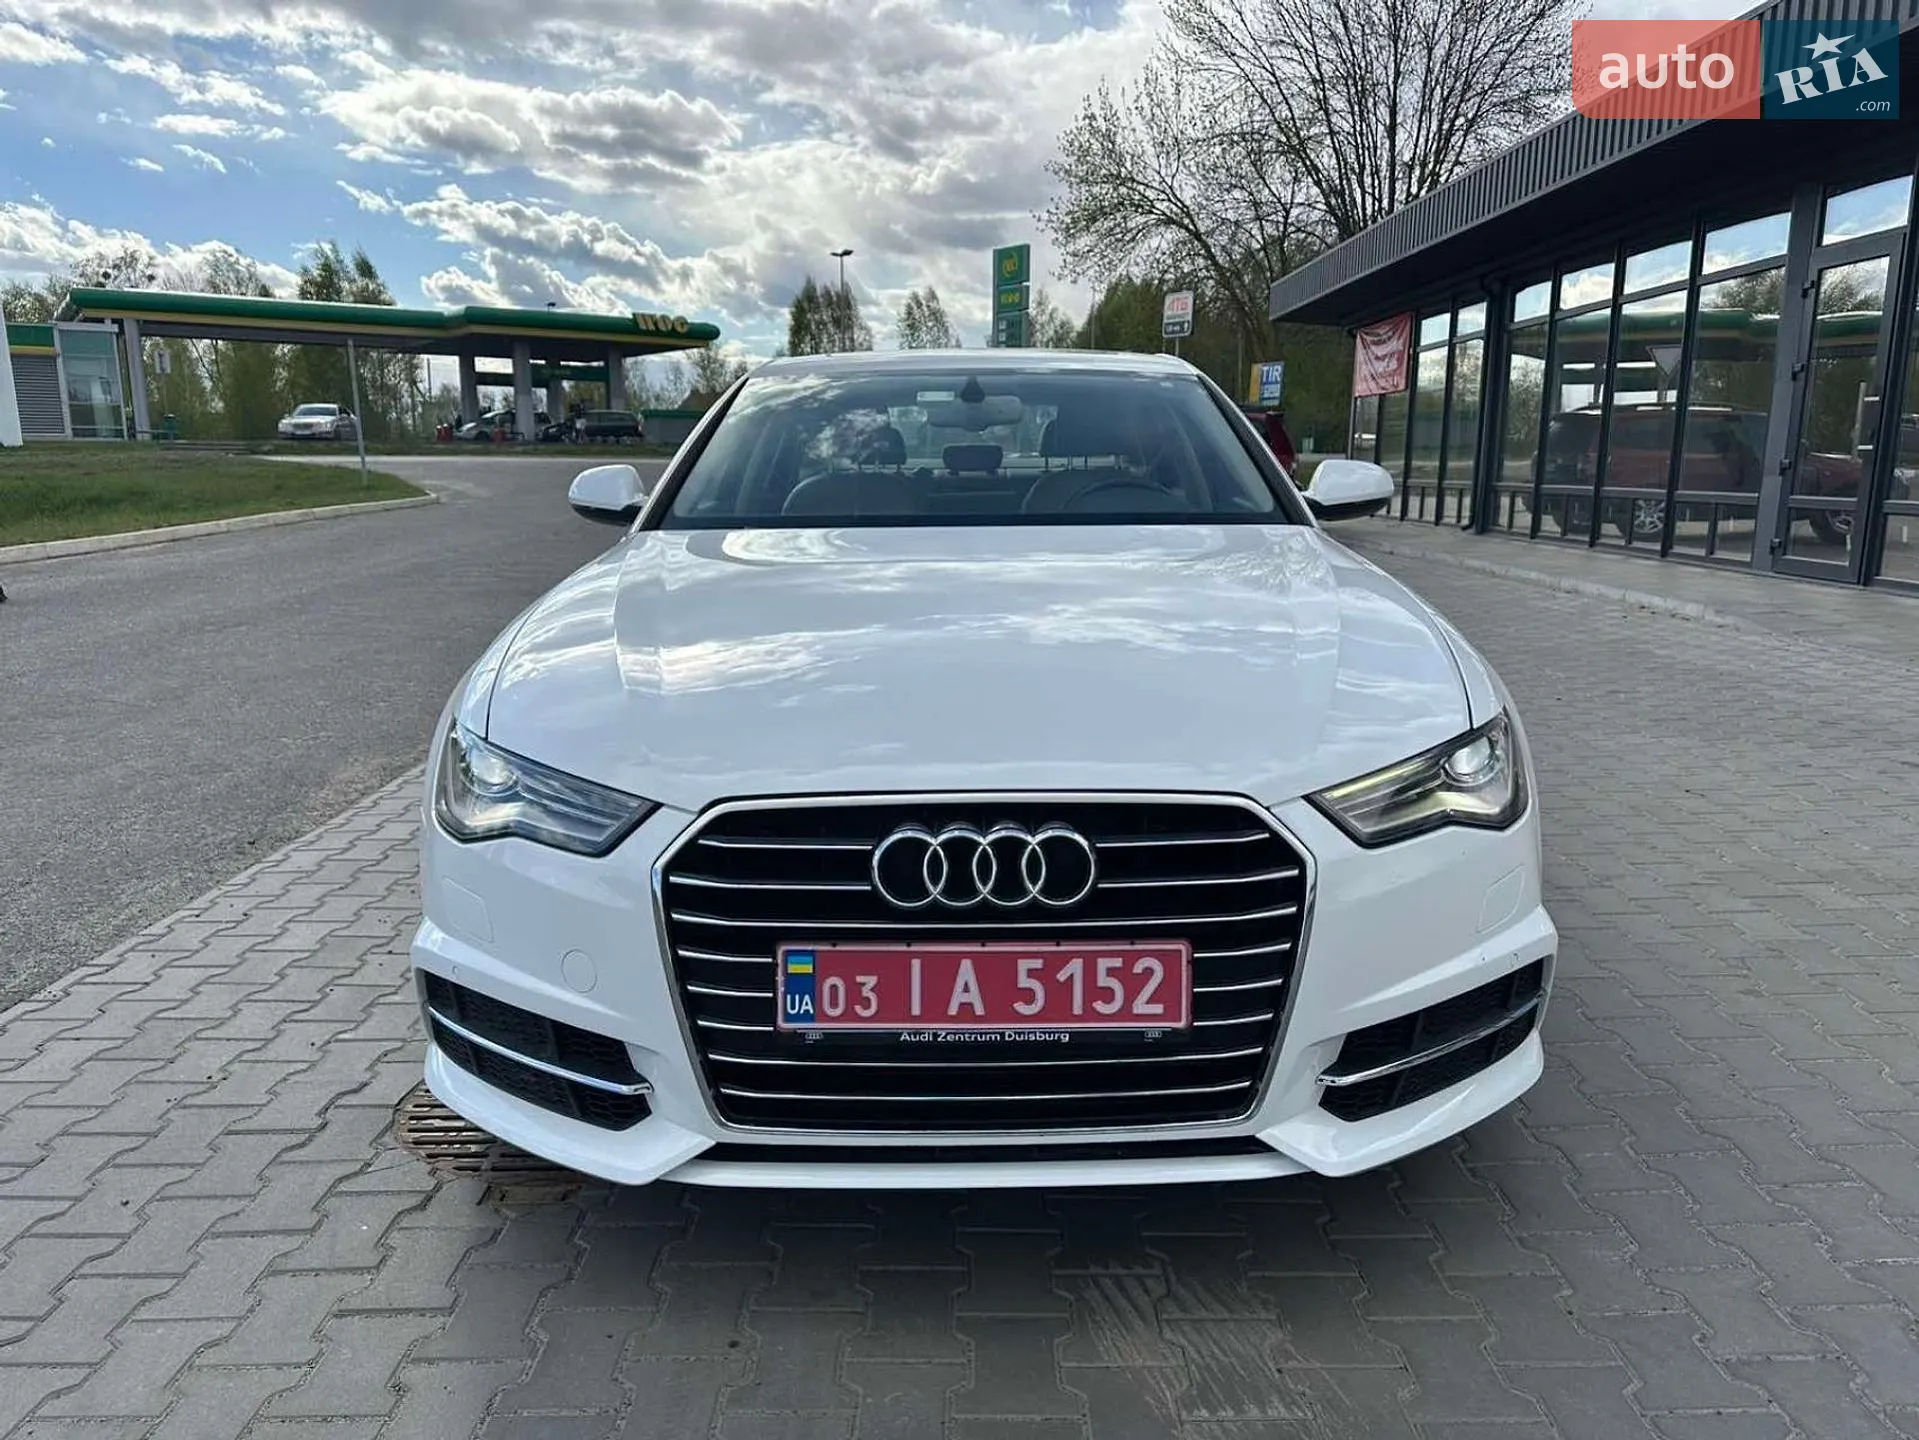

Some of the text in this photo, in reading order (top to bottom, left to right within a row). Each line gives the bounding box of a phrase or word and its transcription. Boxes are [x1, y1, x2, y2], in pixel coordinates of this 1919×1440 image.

[1261, 365, 1282, 383] TIR
[821, 975, 879, 1017] 03
[1012, 957, 1165, 1016] 5152
[786, 994, 814, 1014] UA
[899, 1031, 1070, 1043] Audi Zentrum Duisburg
